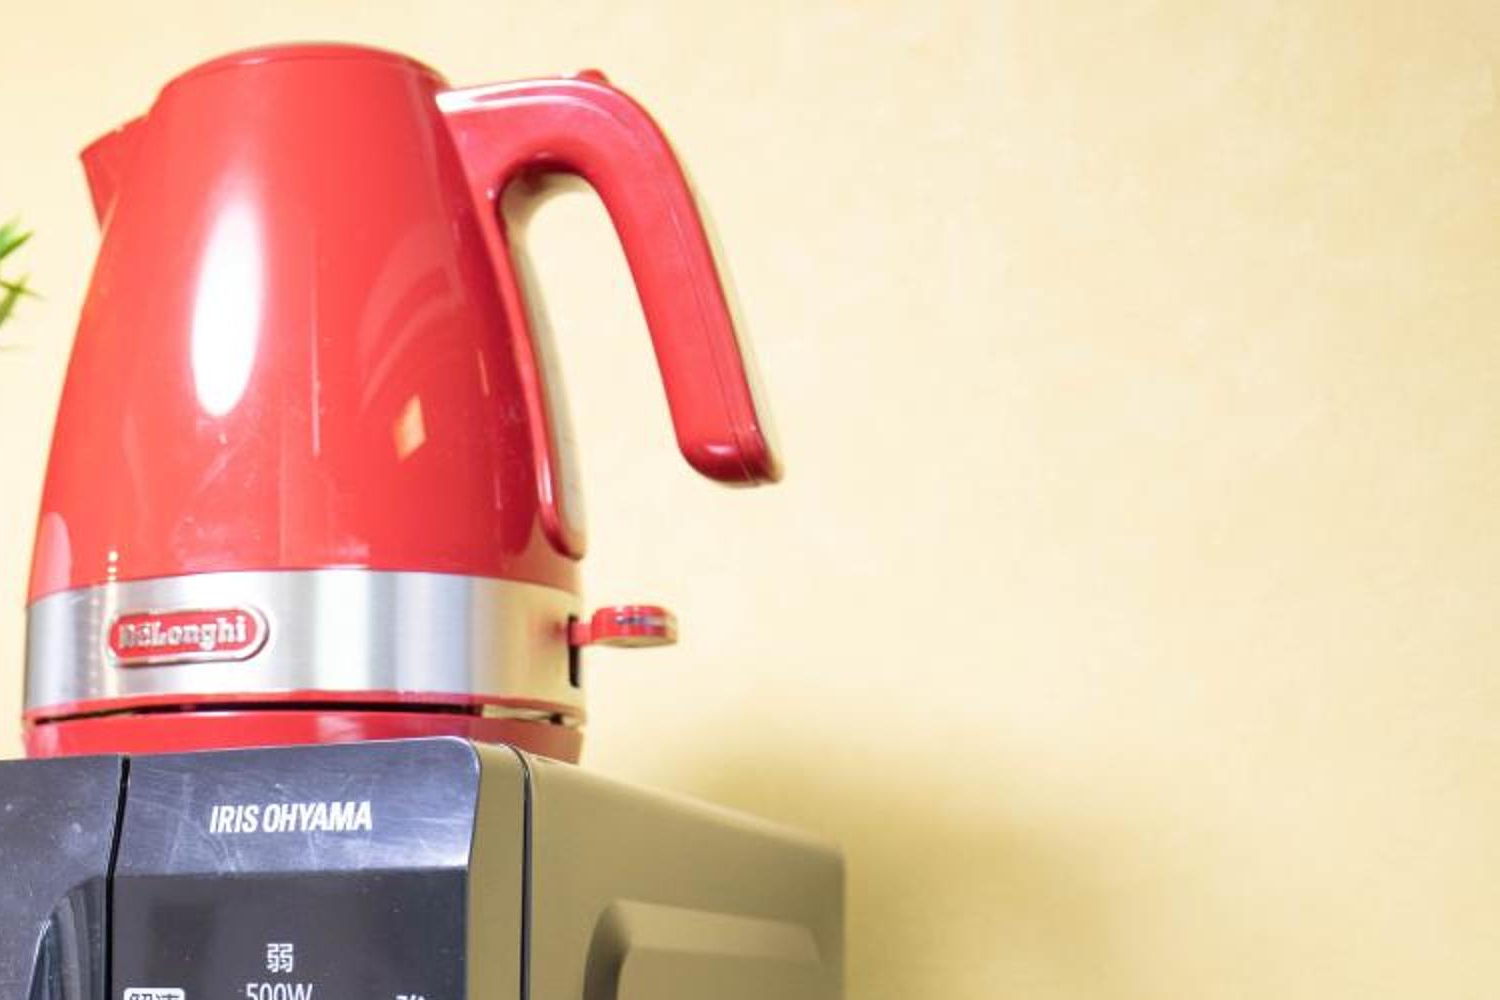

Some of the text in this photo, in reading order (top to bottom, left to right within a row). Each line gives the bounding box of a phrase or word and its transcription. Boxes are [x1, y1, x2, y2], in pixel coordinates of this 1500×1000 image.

[209, 800, 373, 833] IRIS OHYAMA
[266, 943, 294, 973] 弱
